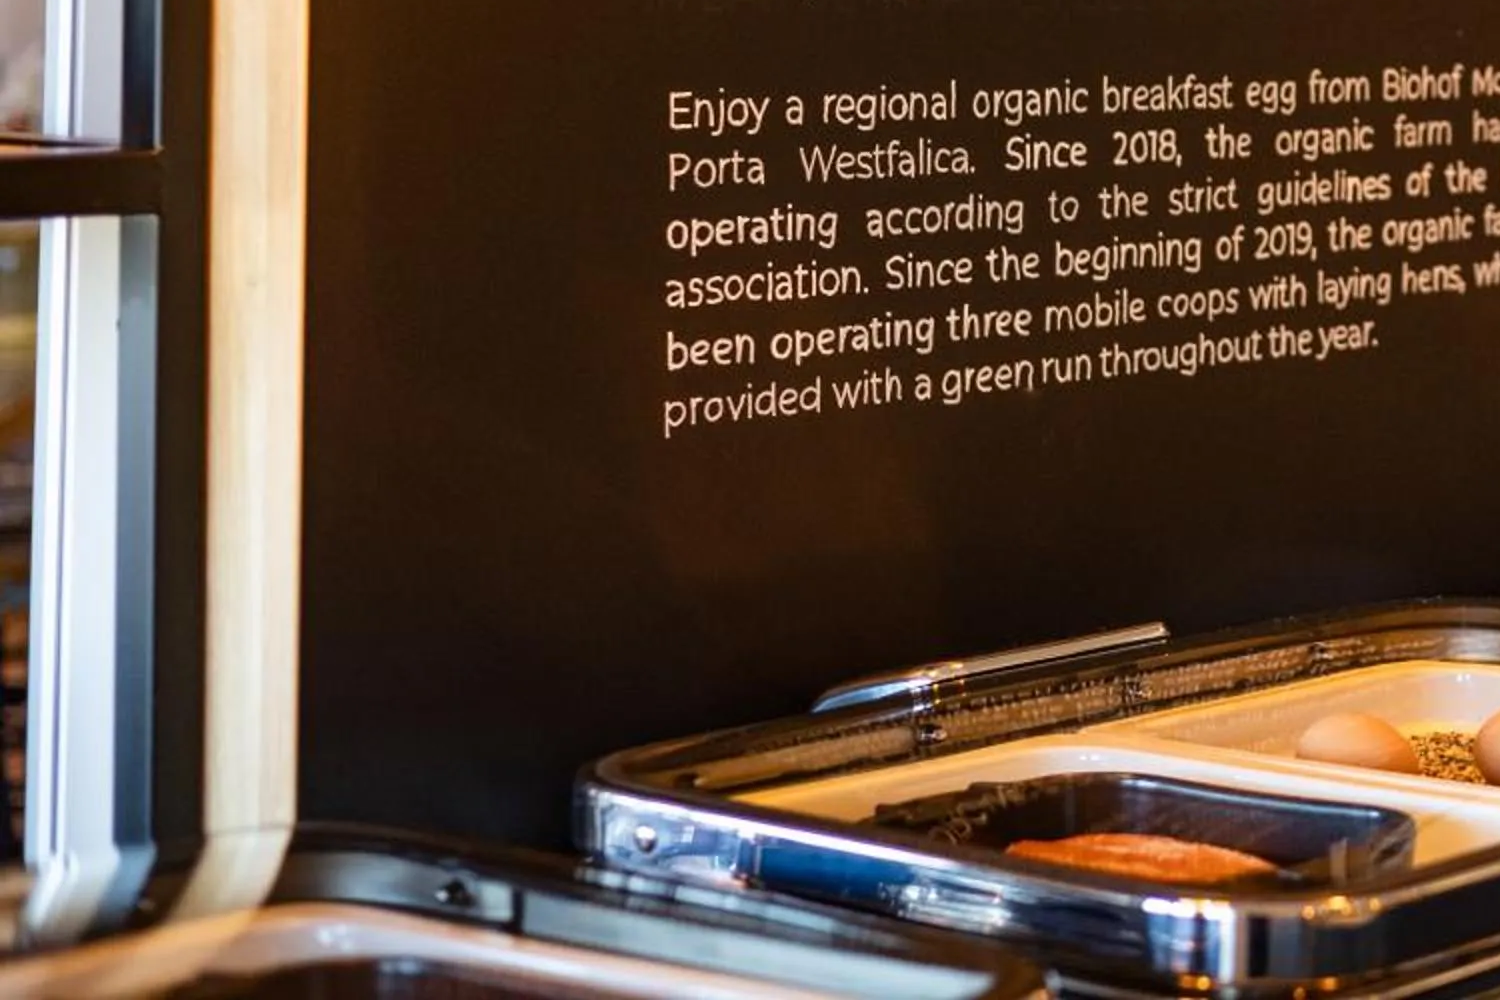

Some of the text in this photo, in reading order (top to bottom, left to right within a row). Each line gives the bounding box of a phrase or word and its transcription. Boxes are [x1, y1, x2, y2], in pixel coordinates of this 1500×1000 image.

[669, 88, 771, 136] Enjoy
[785, 96, 804, 125] a
[823, 79, 956, 131] regional
[972, 78, 1088, 126] organic
[1103, 73, 1234, 113] breakfast
[1245, 80, 1296, 115] egg
[1308, 68, 1370, 104] from
[1382, 63, 1464, 102] Biohof
[669, 150, 765, 192] Porta
[799, 137, 975, 183] Westfalica.
[1004, 132, 1087, 171] Since
[1113, 128, 1182, 168] 2018,
[1204, 123, 1252, 159] the
[1275, 117, 1375, 162] organic
[1393, 113, 1452, 148] farm
[665, 259, 869, 309] association.
[885, 252, 973, 290] Since
[985, 245, 1040, 282] the
[1055, 231, 1202, 281] beginning
[1215, 224, 1245, 262] of
[1254, 221, 1317, 261] 2019,
[1327, 216, 1372, 252] the
[1382, 206, 1475, 253] organic
[666, 203, 838, 257] operating
[866, 193, 1024, 239] according
[1048, 191, 1079, 223] to
[1098, 184, 1148, 220] the
[1168, 176, 1239, 216] strict
[1257, 169, 1392, 216] guidelines
[1405, 162, 1434, 197] of
[1444, 160, 1487, 194] the
[667, 331, 755, 371] been
[770, 311, 935, 366] operating
[946, 303, 1032, 341] three
[1045, 288, 1146, 333] mobile
[1157, 287, 1240, 322] coops
[1248, 274, 1307, 311] with
[1317, 266, 1392, 310] laying
[1401, 262, 1466, 294] hens,
[664, 321, 1379, 439] provided with a green run throughout the year.
